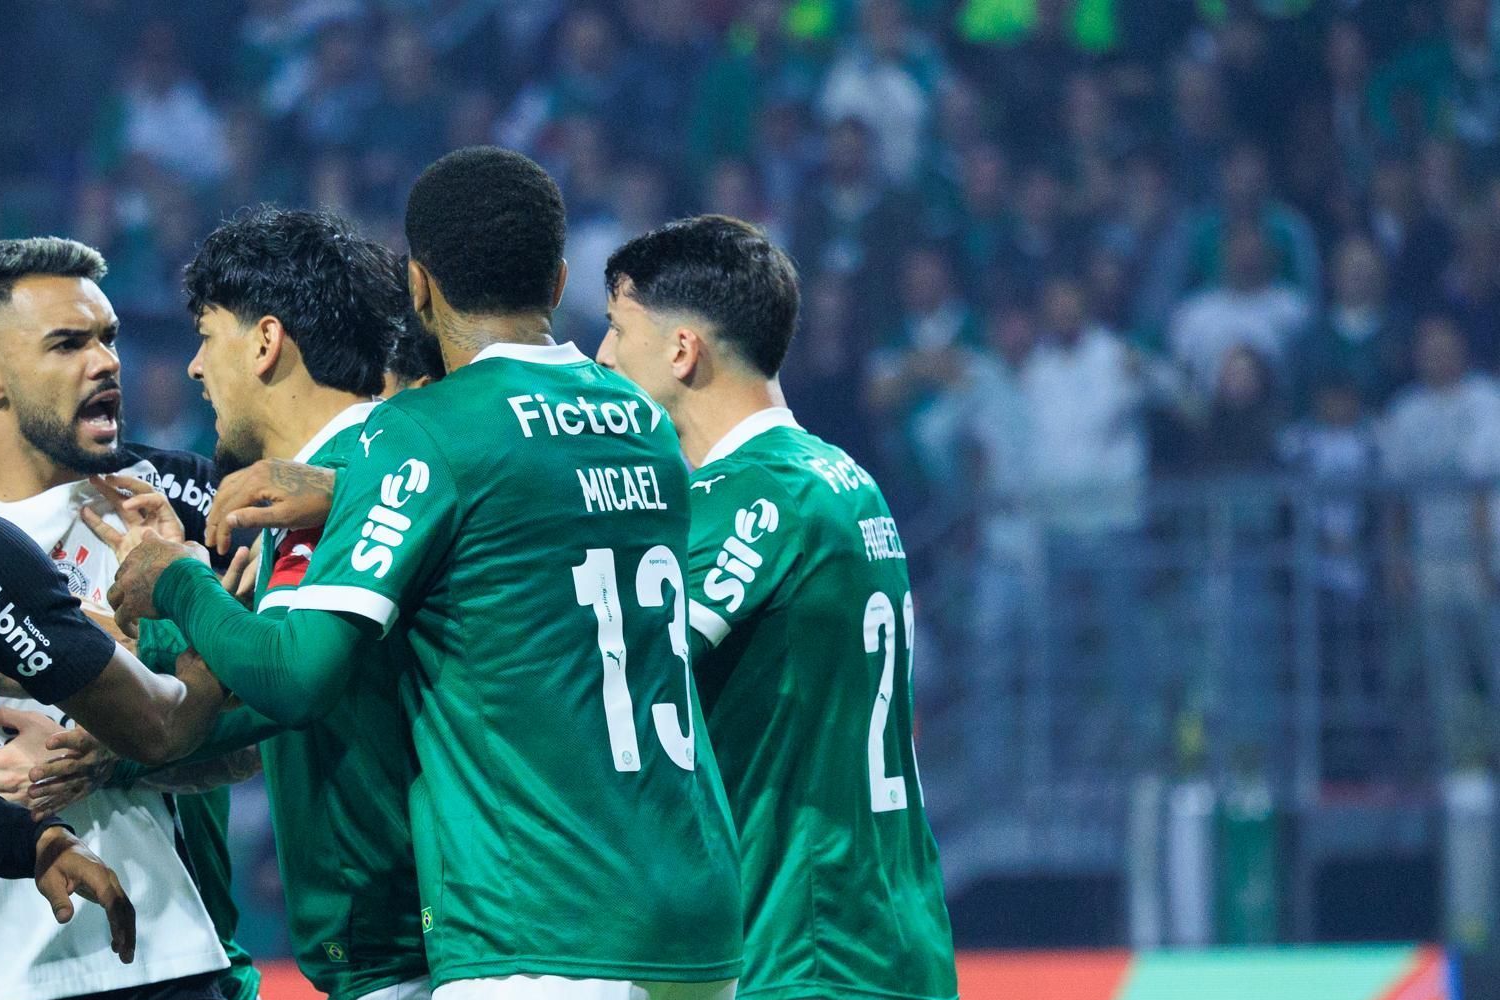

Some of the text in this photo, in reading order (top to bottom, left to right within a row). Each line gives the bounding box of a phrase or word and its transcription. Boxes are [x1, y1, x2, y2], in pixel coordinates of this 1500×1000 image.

[507, 392, 643, 438] Fictor
[576, 466, 668, 513] MICAEL
[22, 615, 51, 647] banco
[571, 544, 695, 772] 13
